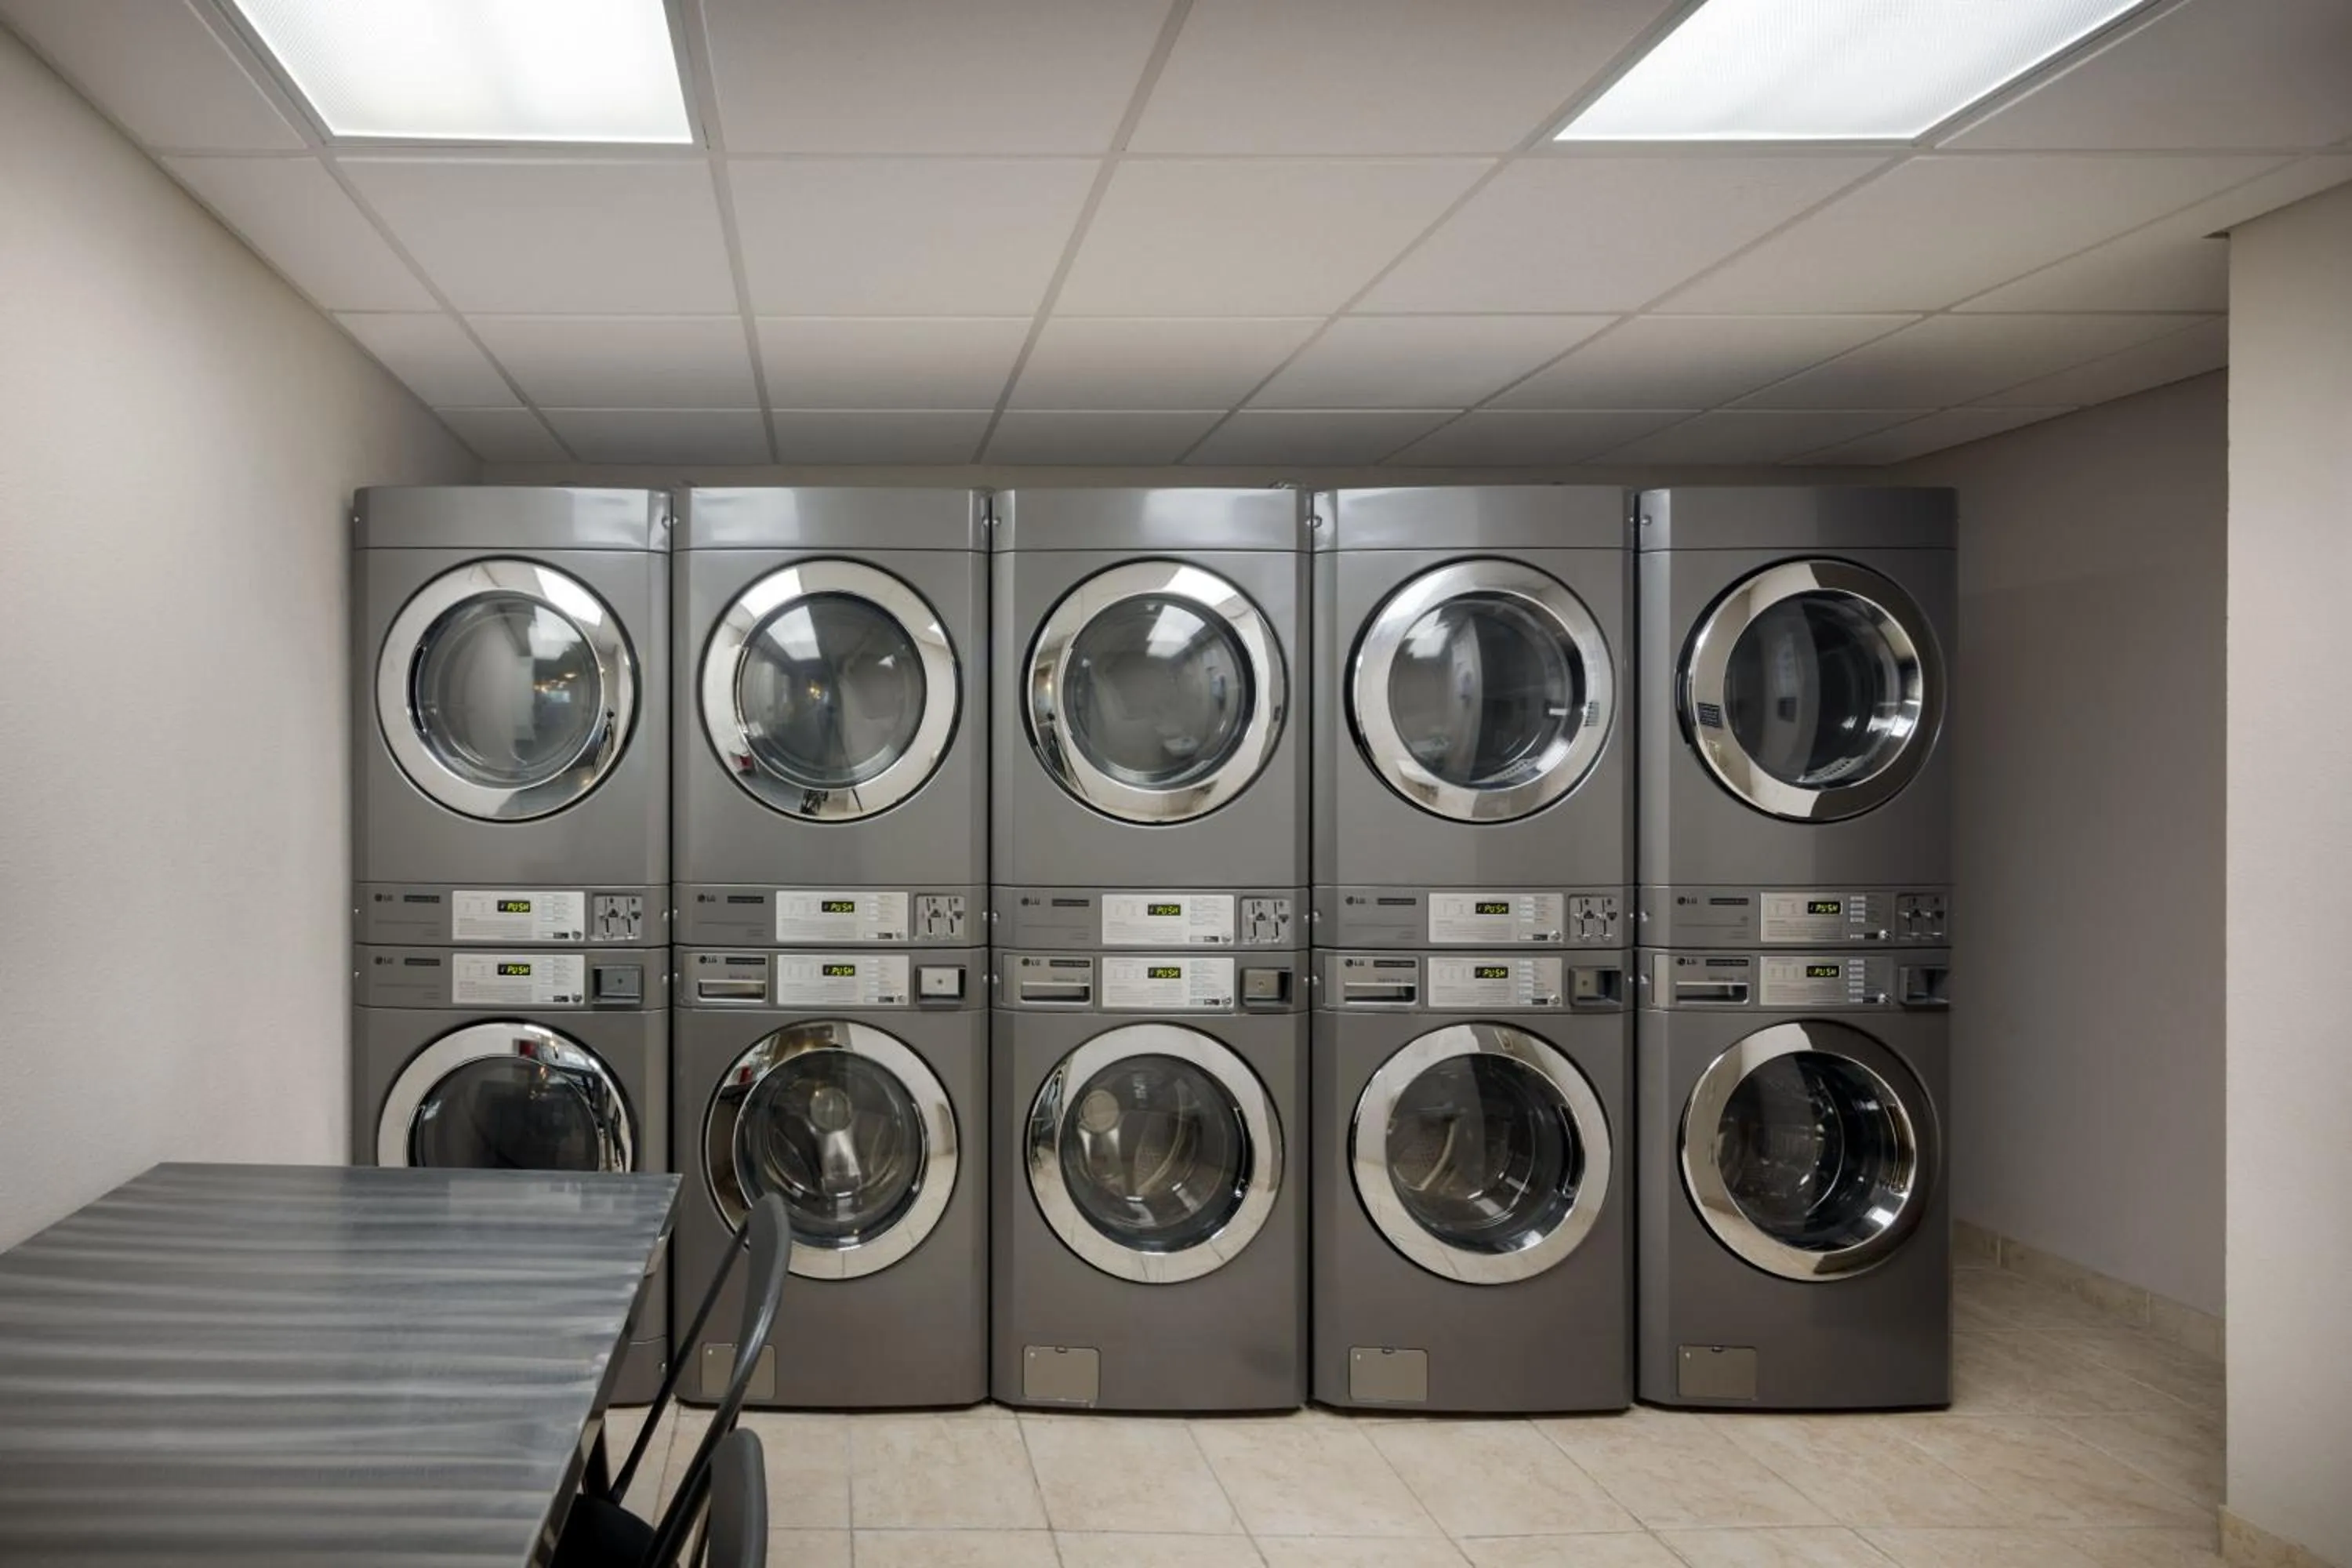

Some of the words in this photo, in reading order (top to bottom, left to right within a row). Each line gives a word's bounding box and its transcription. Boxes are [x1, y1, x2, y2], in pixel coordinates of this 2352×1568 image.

[507, 902, 529, 911] PUSH
[830, 902, 852, 911] PUSH
[1156, 906, 1178, 914] PUSH
[1484, 905, 1506, 913] PUSH
[1816, 904, 1838, 913] PUSH
[506, 965, 529, 974] PUSH
[832, 967, 854, 975] PUSH
[1156, 969, 1178, 978] PUSH
[1483, 968, 1505, 977] PUSH
[1814, 967, 1837, 976] PUSH
